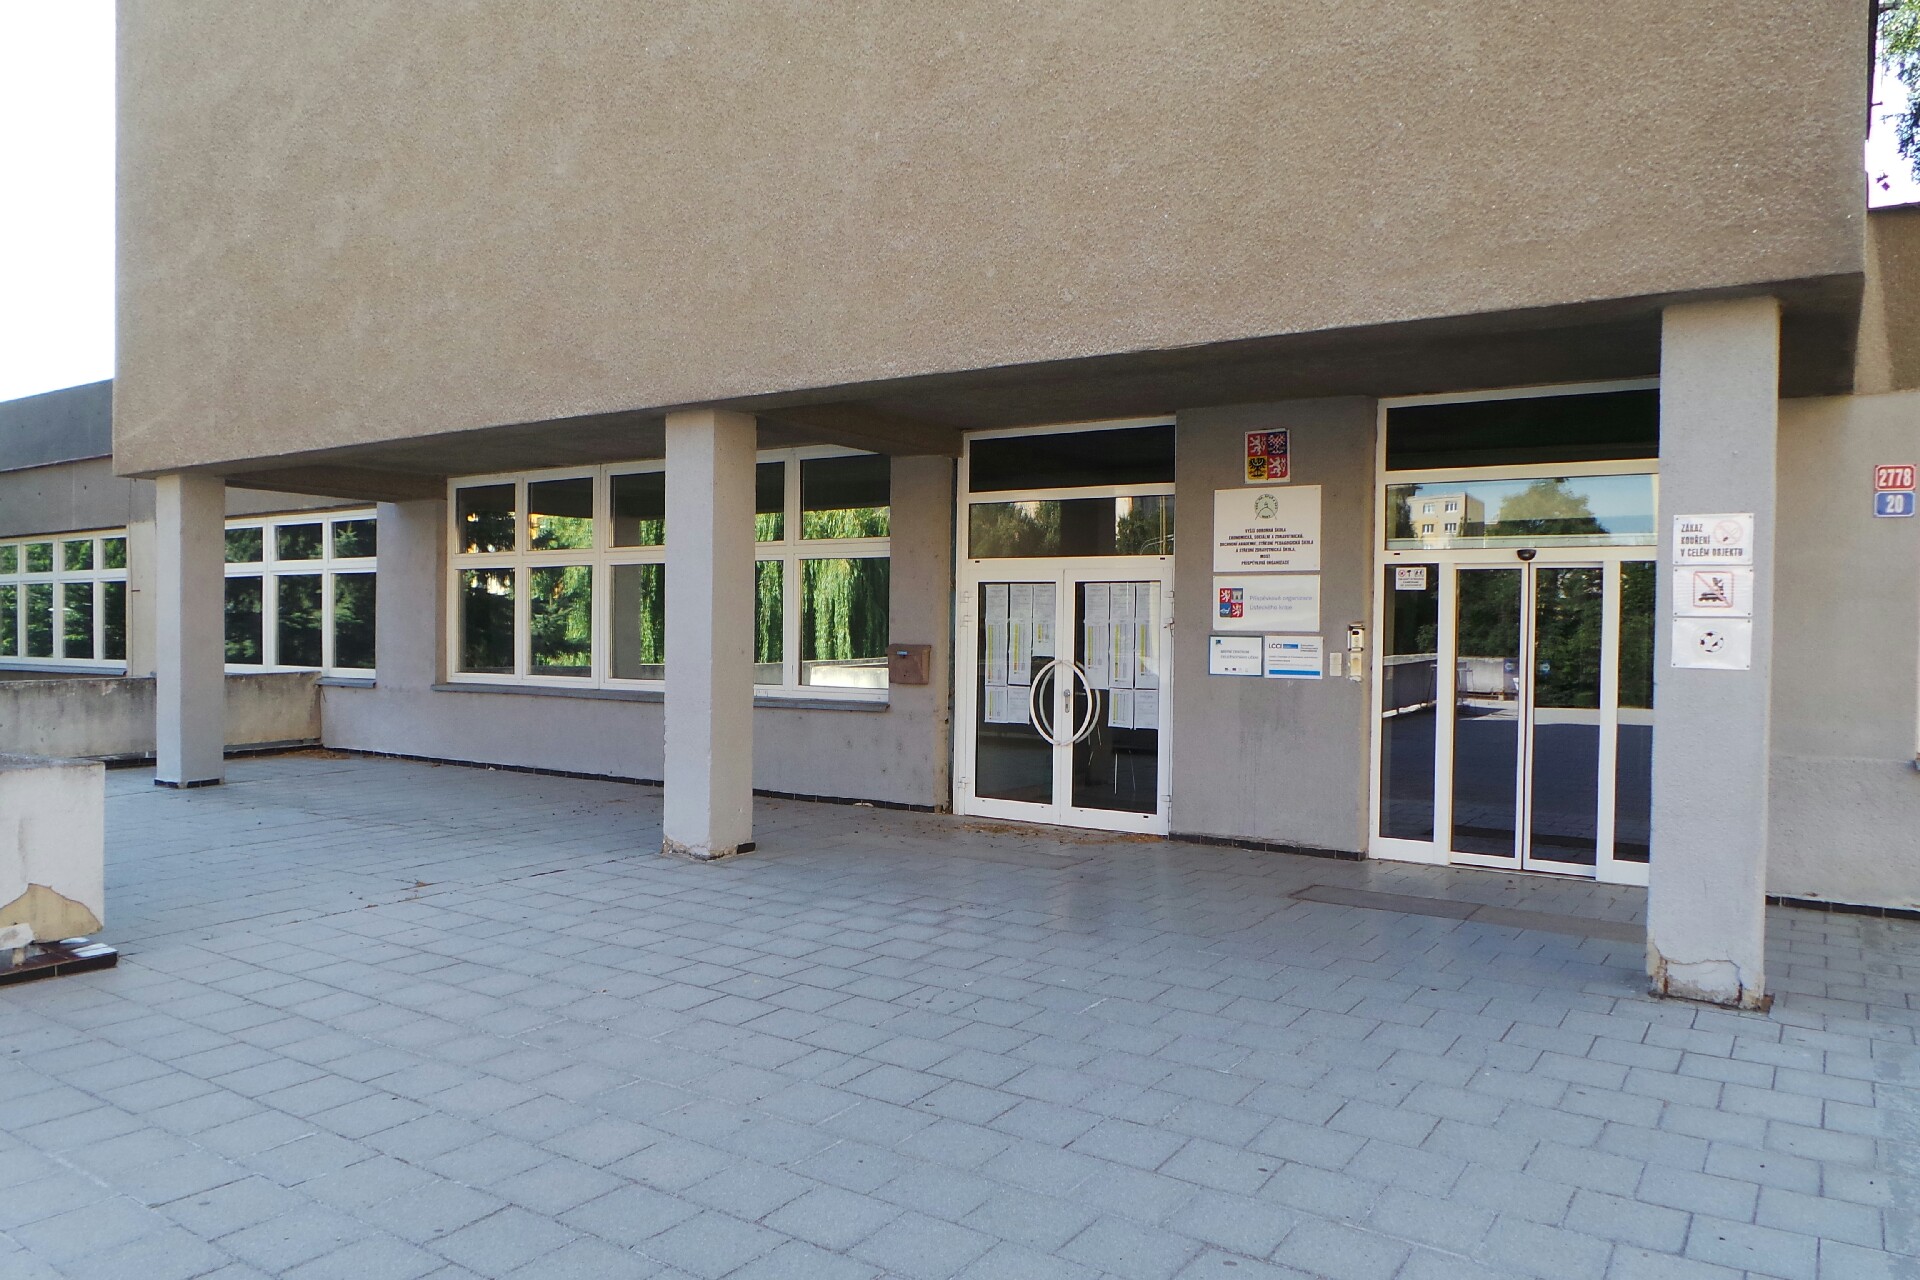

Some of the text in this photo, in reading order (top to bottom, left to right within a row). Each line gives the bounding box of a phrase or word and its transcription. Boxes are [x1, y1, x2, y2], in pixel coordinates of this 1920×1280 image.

[1879, 468, 1911, 486] 2778
[1886, 495, 1904, 513] 20
[1681, 523, 1703, 532] ZÁKAZ
[1681, 535, 1710, 544] KOUŘENÍ
[1680, 548, 1743, 557] V CELÉM OBJEKTU
